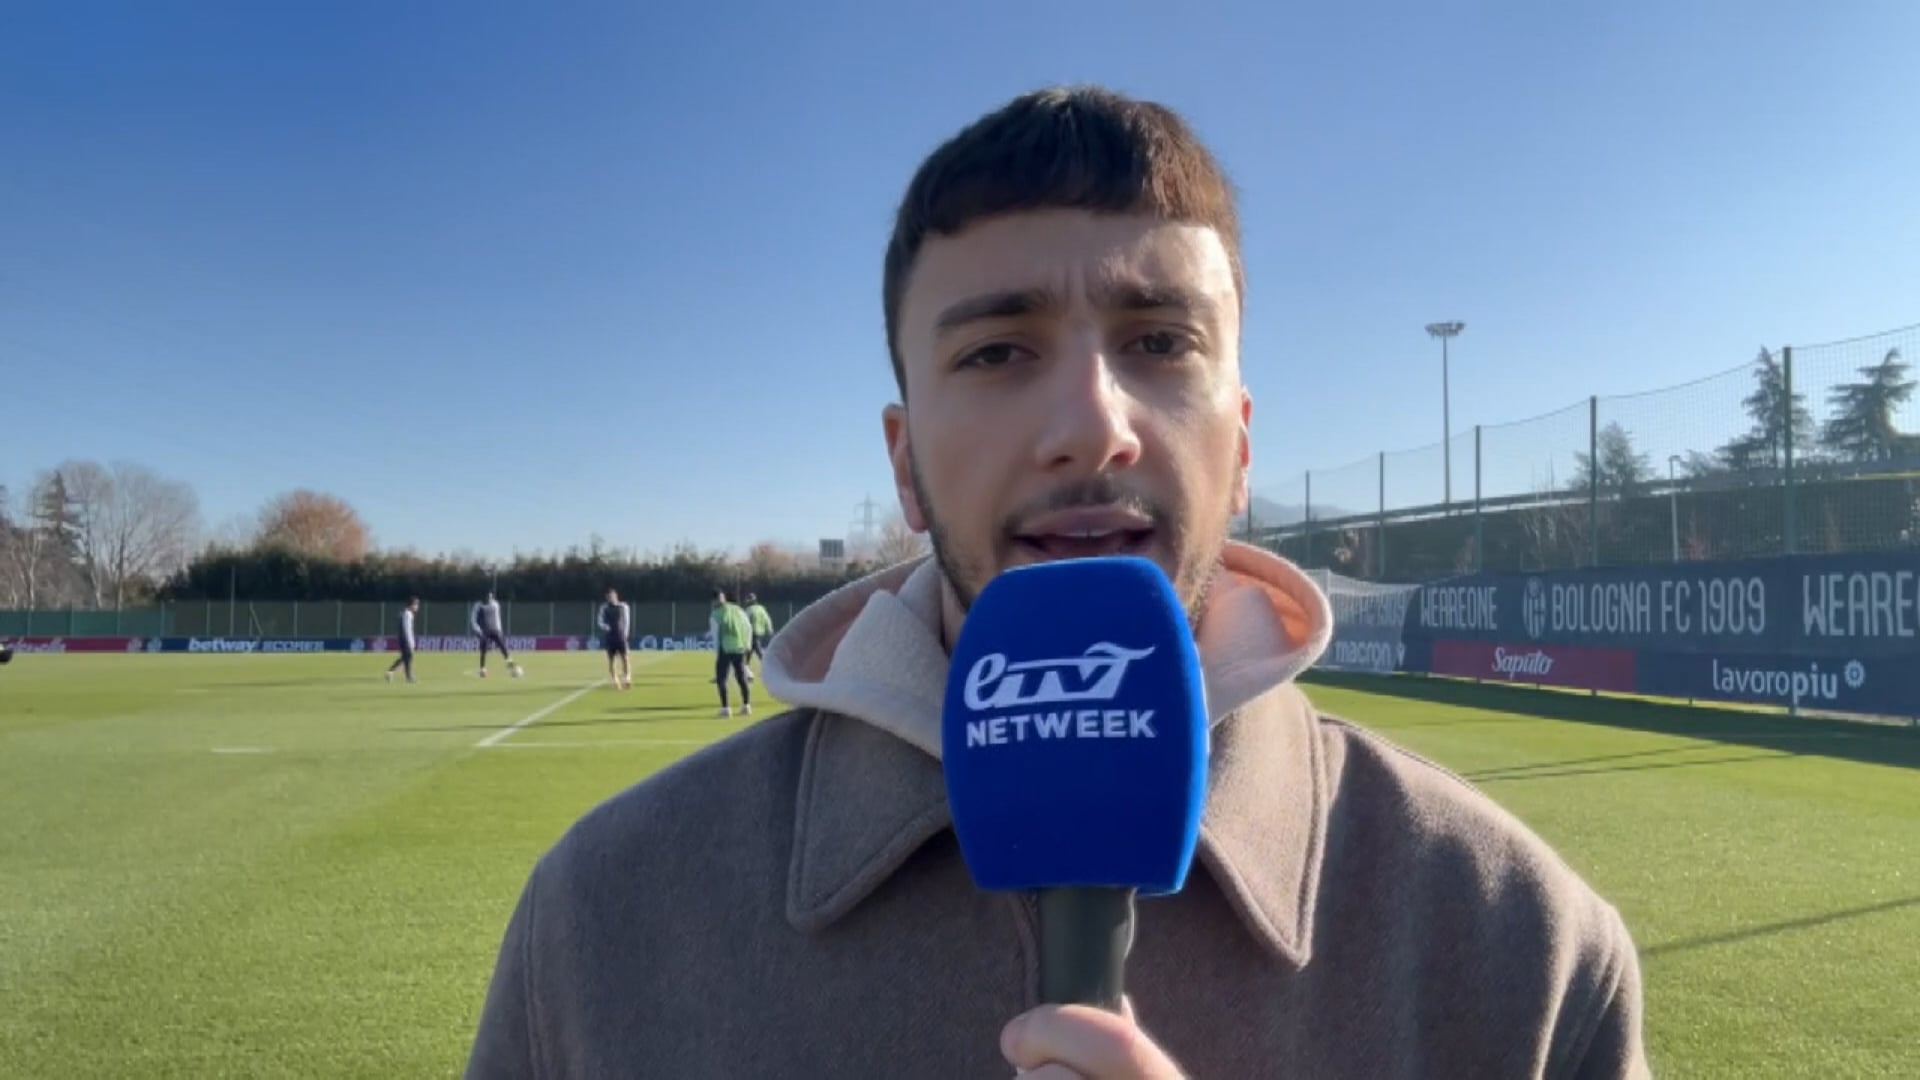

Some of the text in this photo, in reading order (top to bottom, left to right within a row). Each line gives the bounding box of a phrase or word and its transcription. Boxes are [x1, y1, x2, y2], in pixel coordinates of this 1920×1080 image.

[1420, 586, 1498, 630] WEAREONE
[1552, 576, 1765, 635] BOLOGNA FC 1909
[1803, 570, 1919, 636] WEARE
[188, 637, 255, 652] betway
[1491, 647, 1554, 678] Saputo
[966, 709, 1157, 748] NETWEEK
